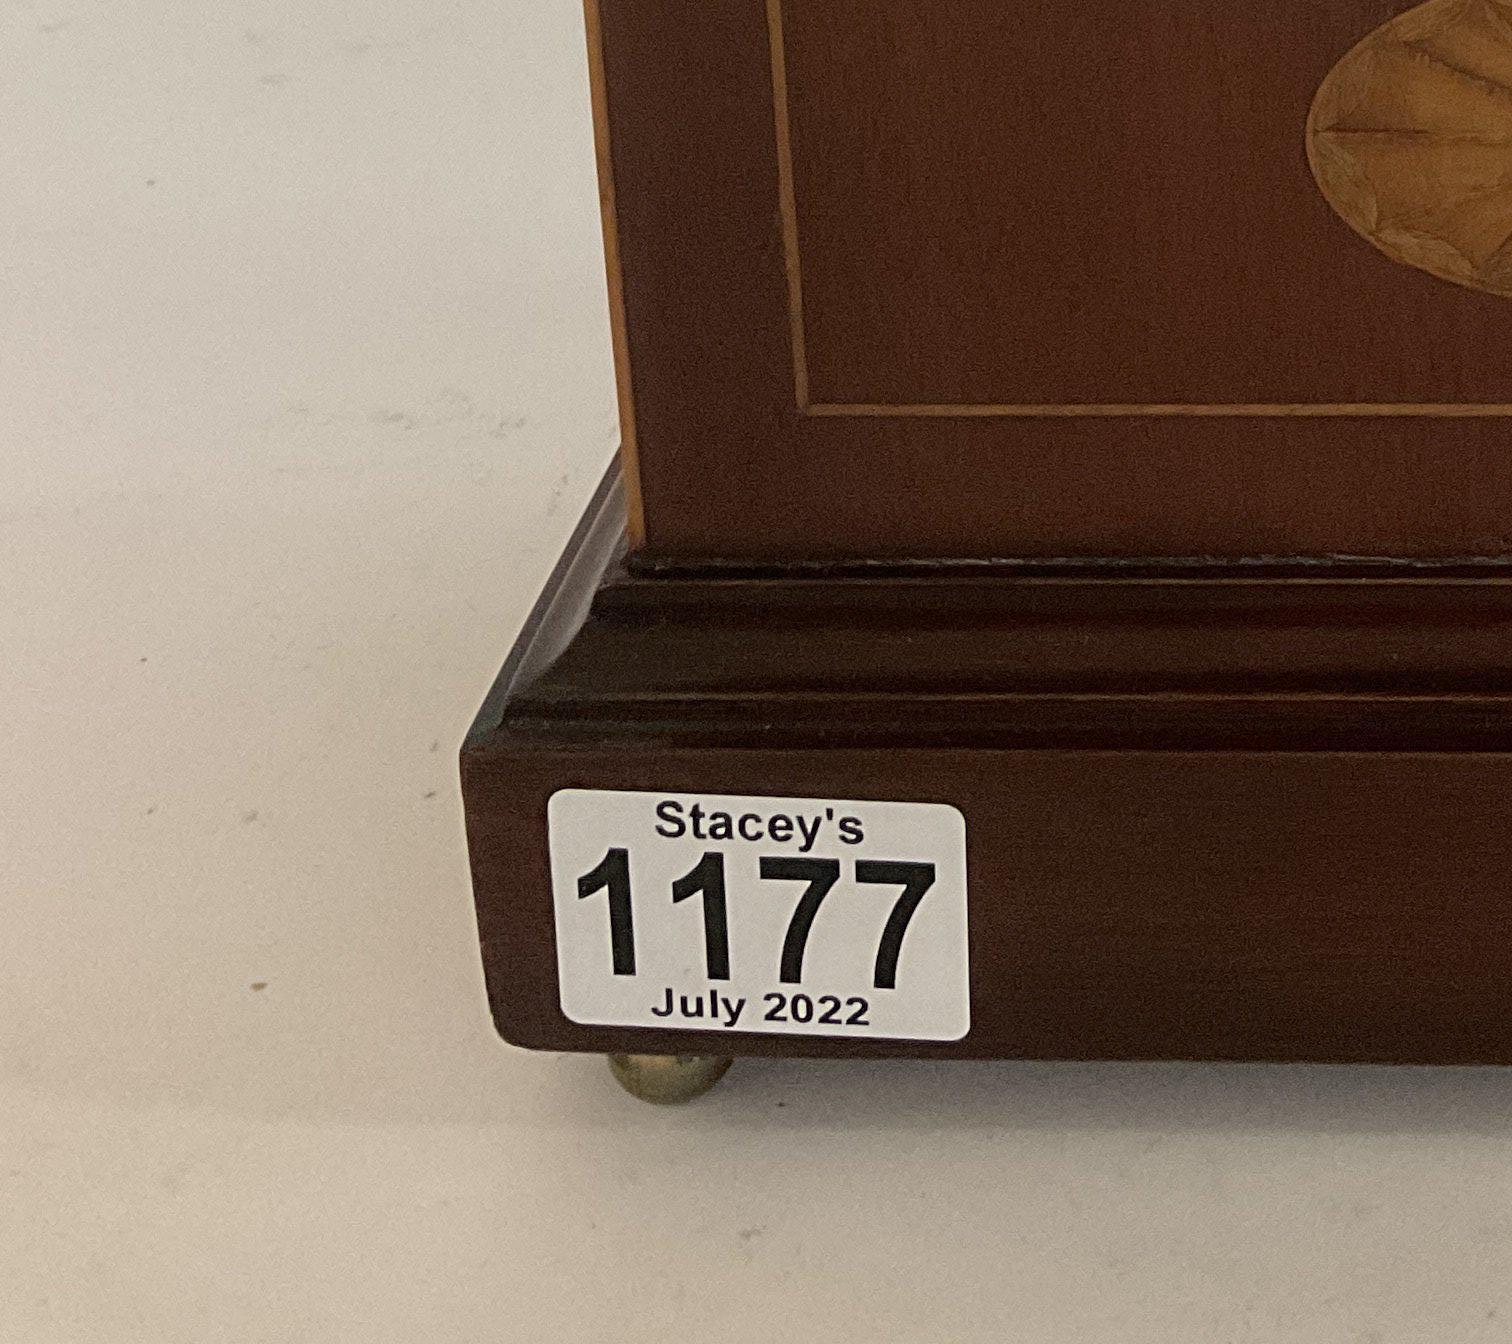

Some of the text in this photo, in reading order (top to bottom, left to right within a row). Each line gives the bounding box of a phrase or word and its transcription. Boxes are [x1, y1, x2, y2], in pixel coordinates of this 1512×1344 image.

[655, 800, 866, 852] Stacey's
[576, 847, 937, 990] 1177
[651, 988, 870, 1028] July 2022
